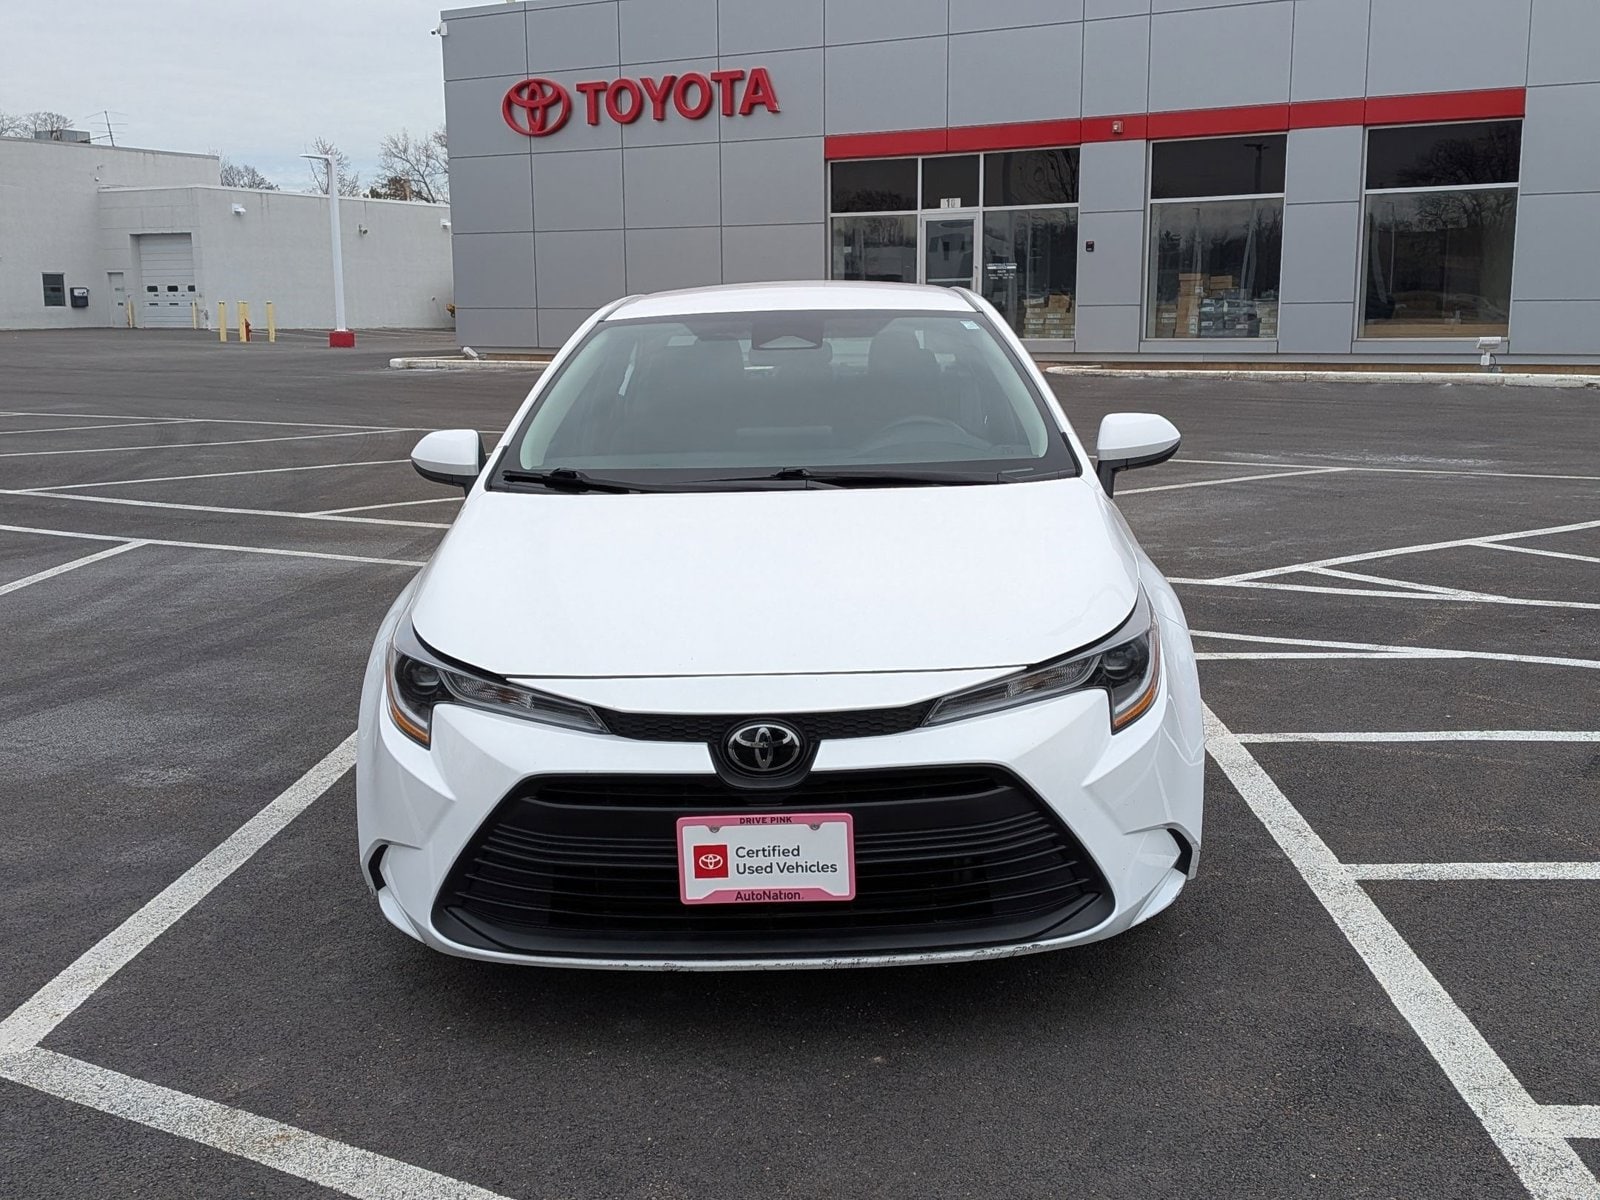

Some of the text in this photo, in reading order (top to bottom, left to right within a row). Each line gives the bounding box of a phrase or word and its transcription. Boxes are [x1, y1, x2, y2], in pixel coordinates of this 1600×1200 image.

[576, 67, 780, 126] TOYOTA
[735, 845, 800, 858] Certified
[736, 861, 838, 874] Used Vehicles
[735, 891, 801, 901] AutoNation
